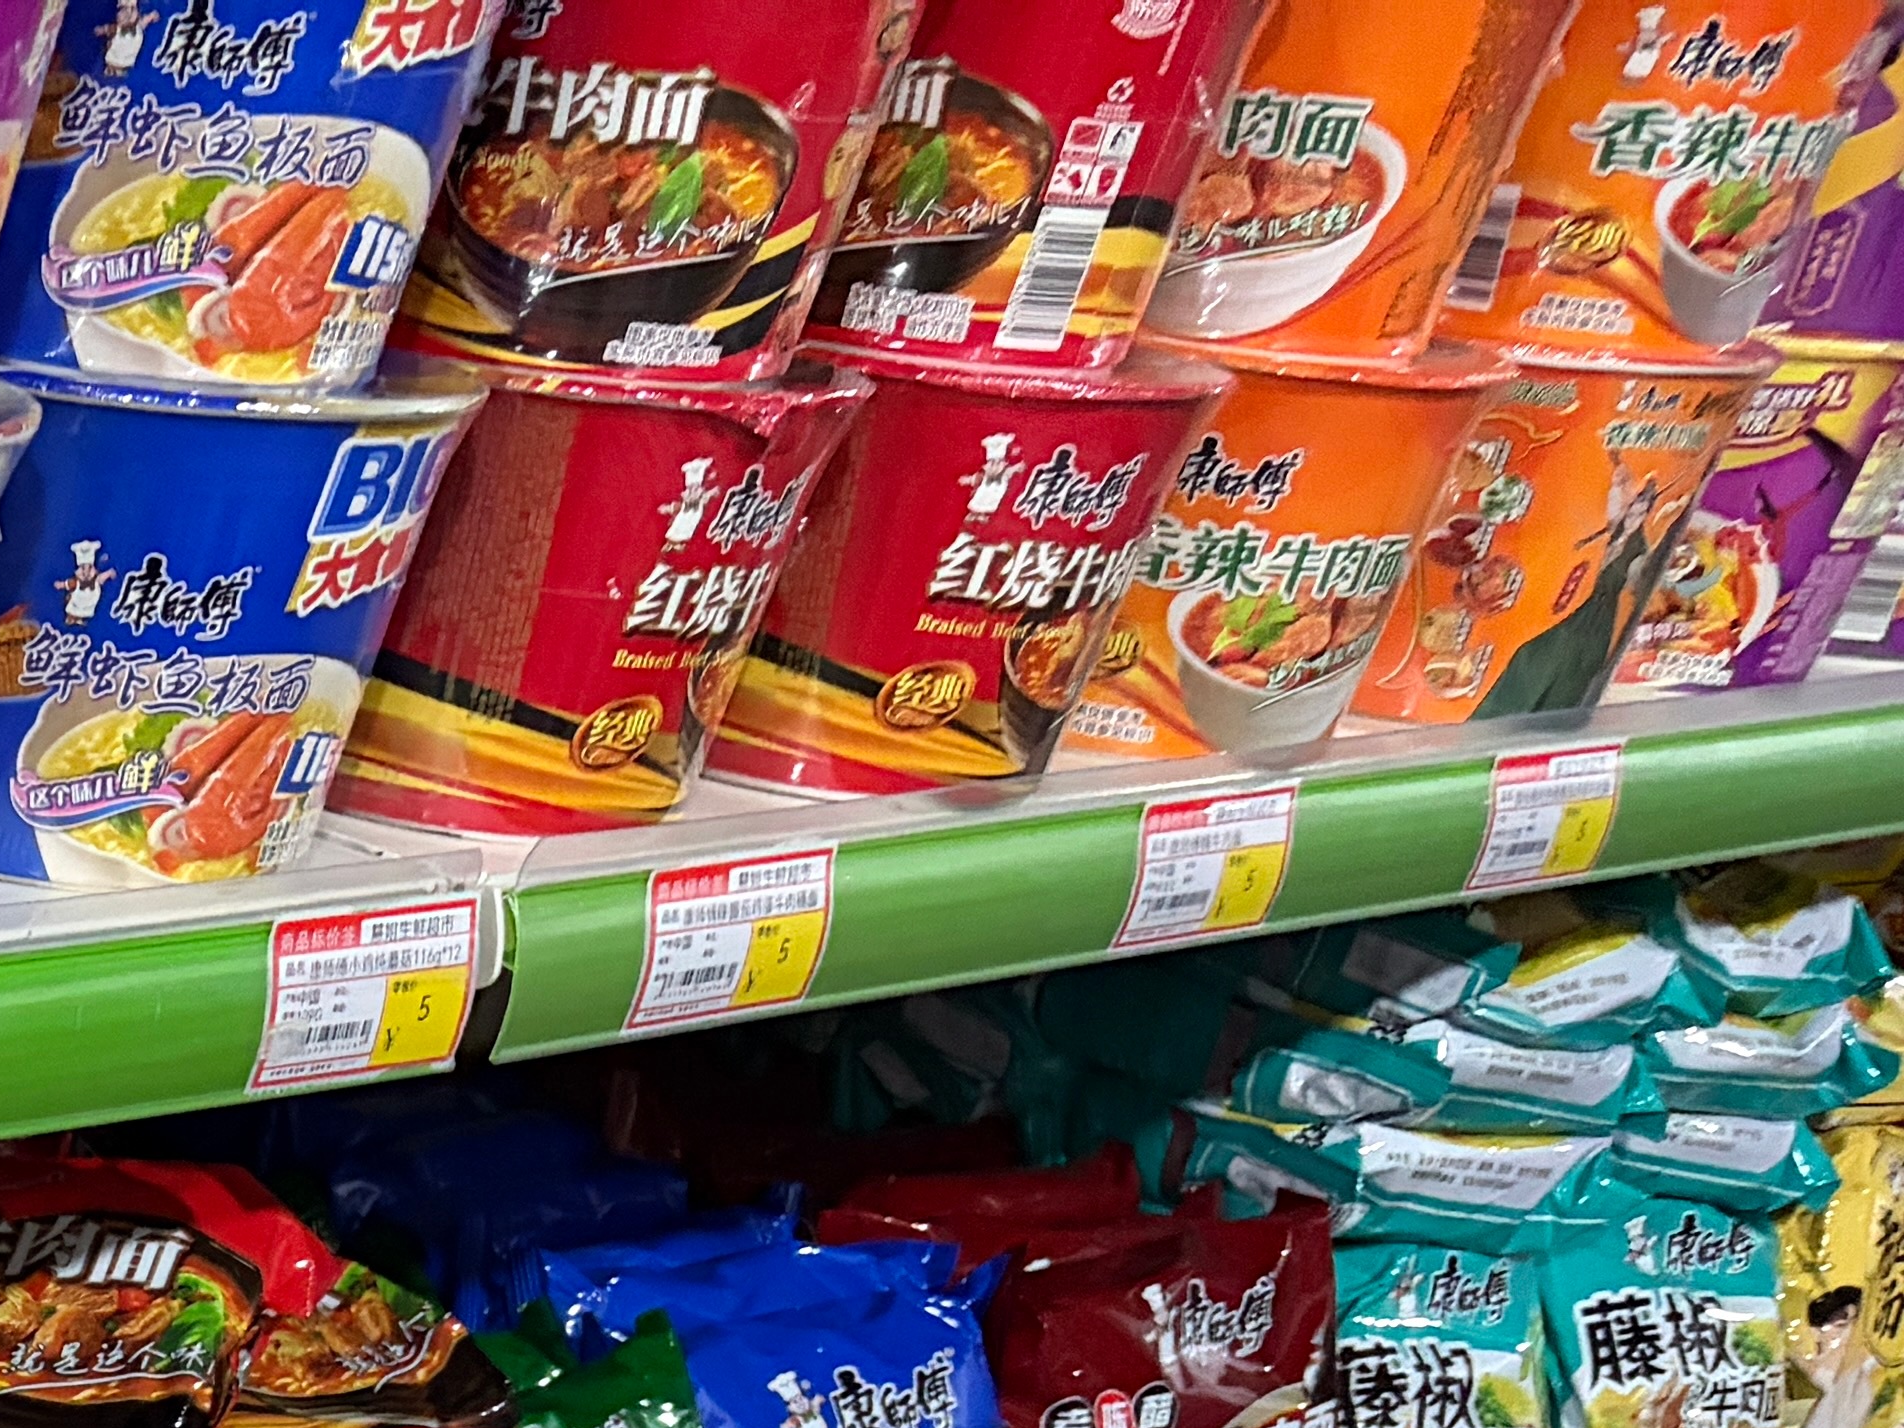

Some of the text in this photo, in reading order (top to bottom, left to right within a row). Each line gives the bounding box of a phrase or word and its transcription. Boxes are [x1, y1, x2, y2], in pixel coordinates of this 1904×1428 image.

[1672, 20, 1799, 99] 康師傅
[54, 75, 378, 190] 鲜虾鱼板面
[1218, 93, 1375, 167] 肉面
[1015, 443, 1149, 531] 康師傅
[1177, 434, 1306, 514] 康師傅
[113, 552, 256, 642] 康師傅
[914, 612, 985, 638] Braised
[18, 622, 316, 721] 鲜虾鱼板面
[777, 936, 791, 965] 5
[417, 993, 433, 1023] 5
[1575, 1288, 1735, 1390] 藤椒
